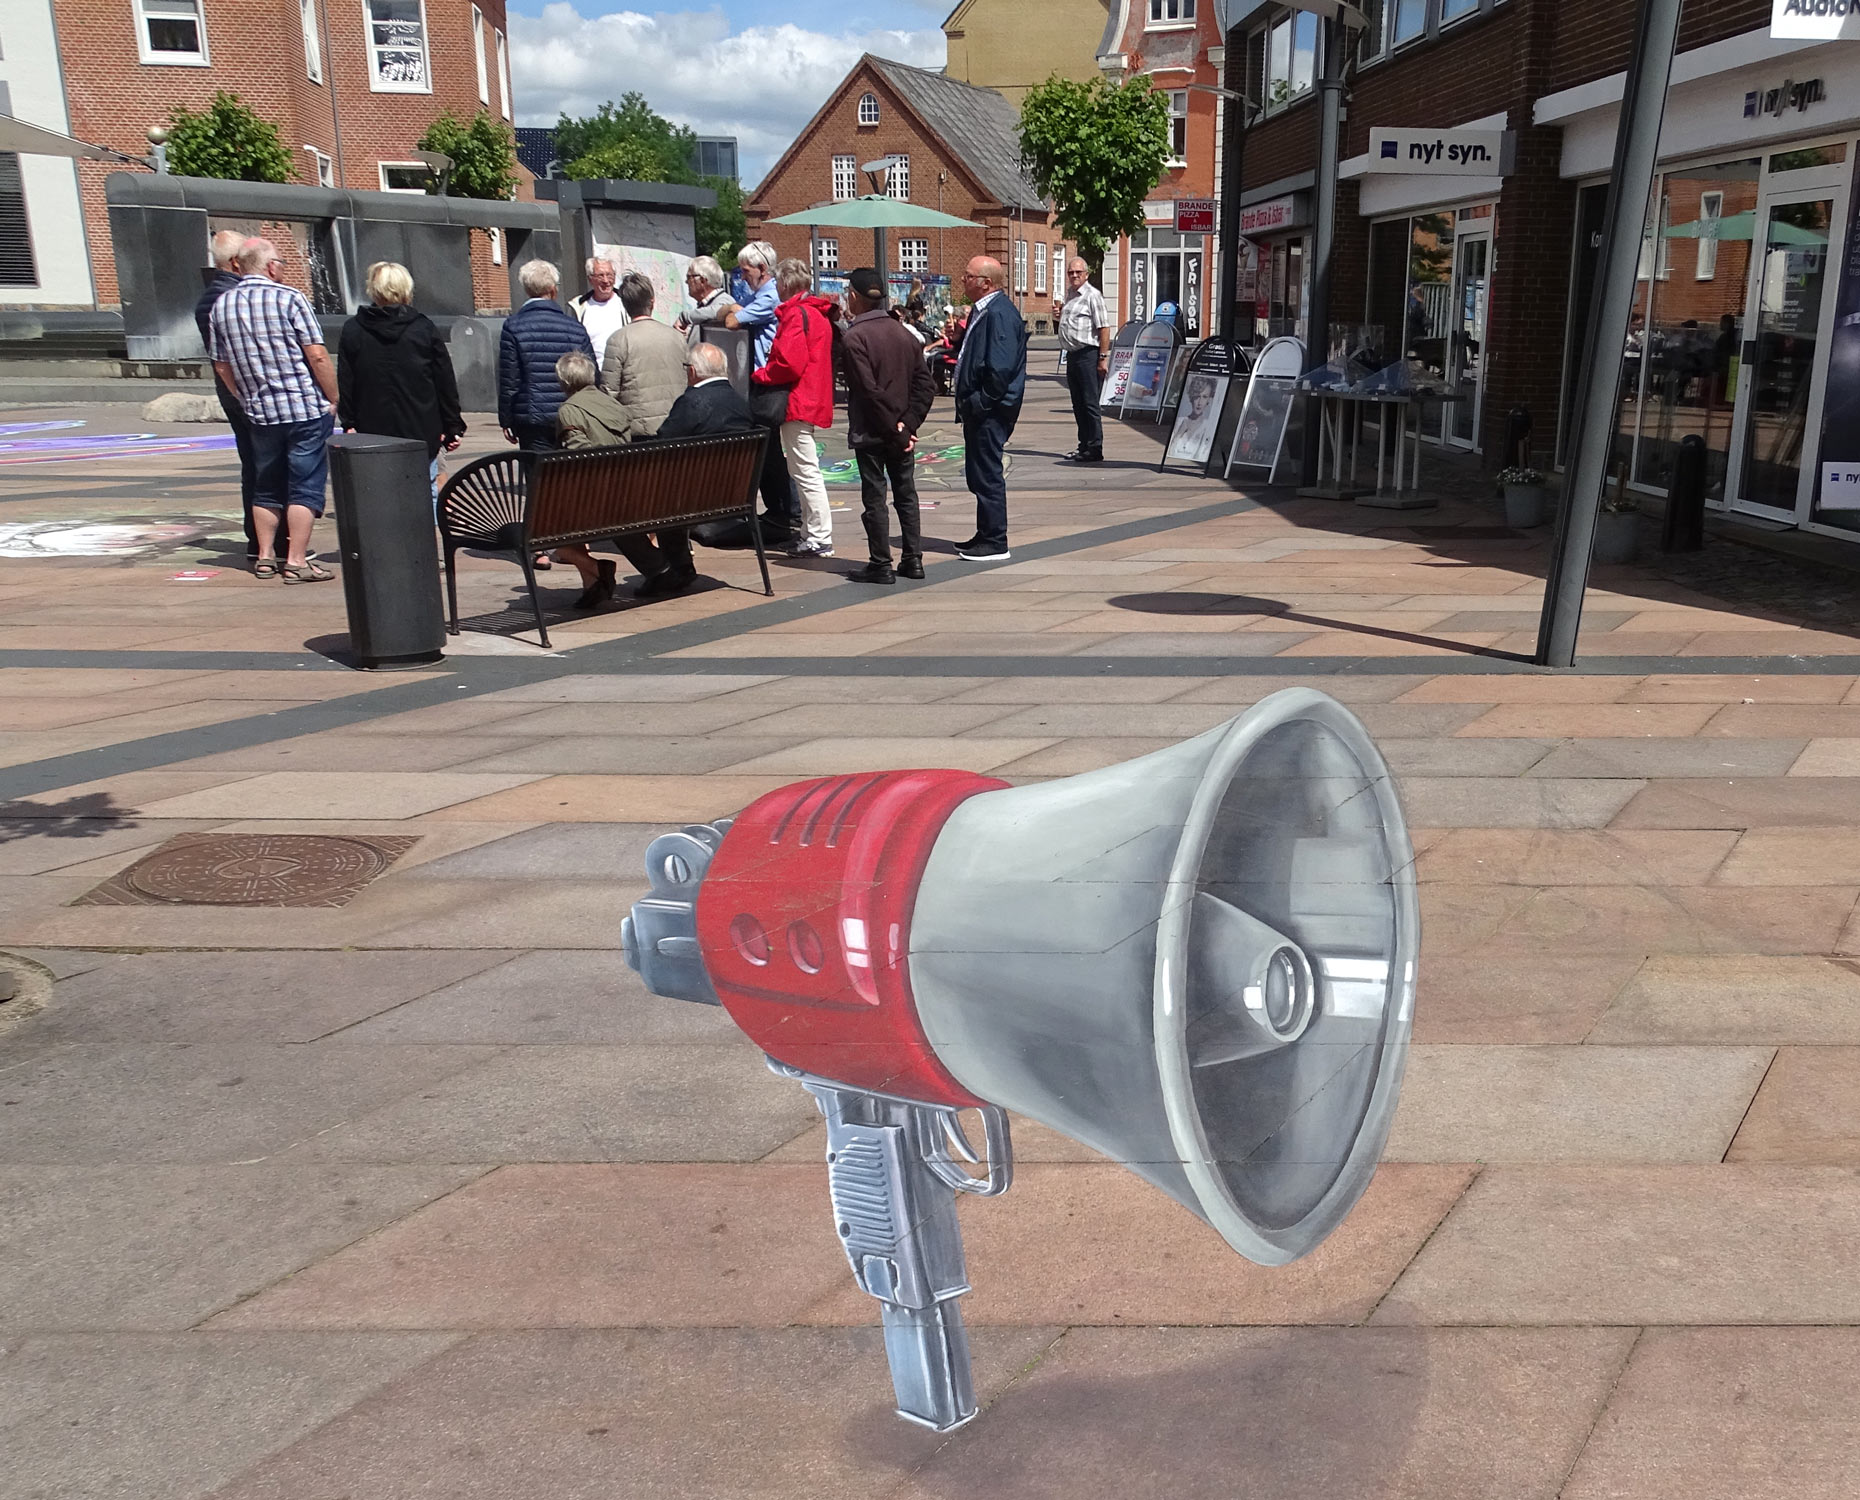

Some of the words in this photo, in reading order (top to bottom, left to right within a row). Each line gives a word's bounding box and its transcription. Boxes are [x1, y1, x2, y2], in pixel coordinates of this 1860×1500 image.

[1409, 140, 1444, 165] nyt
[1447, 143, 1491, 166] syn.
[1178, 201, 1214, 210] BRANDE
[1190, 223, 1213, 231] ISBAR
[1845, 472, 1860, 484] ny
